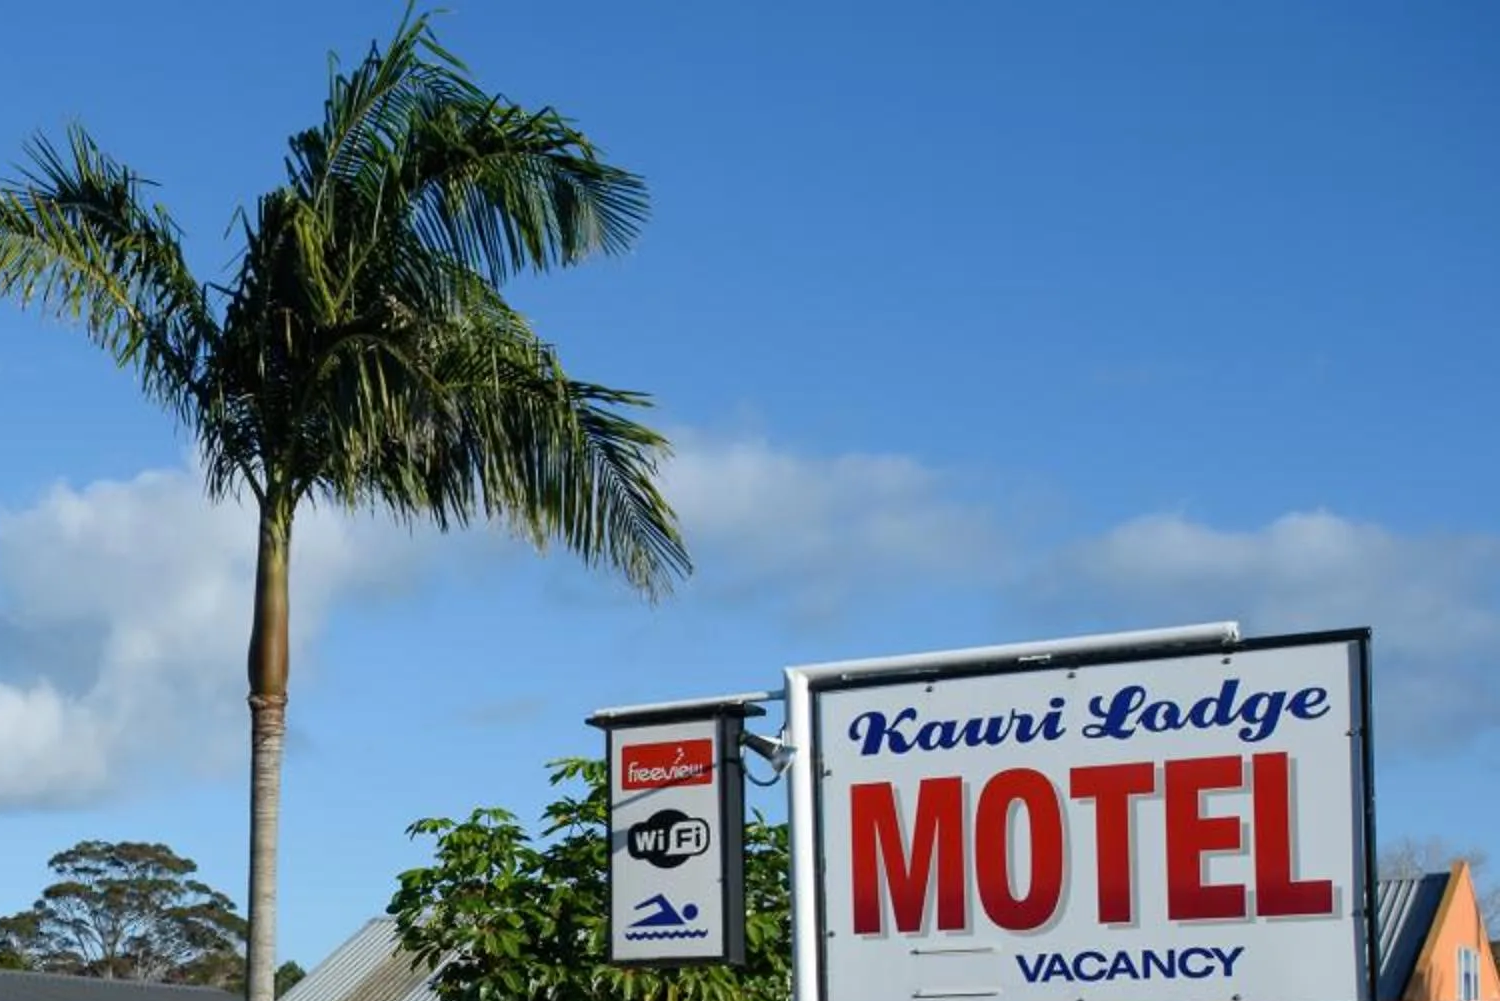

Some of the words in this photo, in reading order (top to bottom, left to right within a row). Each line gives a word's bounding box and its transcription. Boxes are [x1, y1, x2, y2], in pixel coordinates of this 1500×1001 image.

[848, 697, 1066, 756] Kauri
[1082, 679, 1331, 743] Lodge
[849, 752, 1334, 936] MOTEL
[1015, 946, 1245, 984] VACANCY
